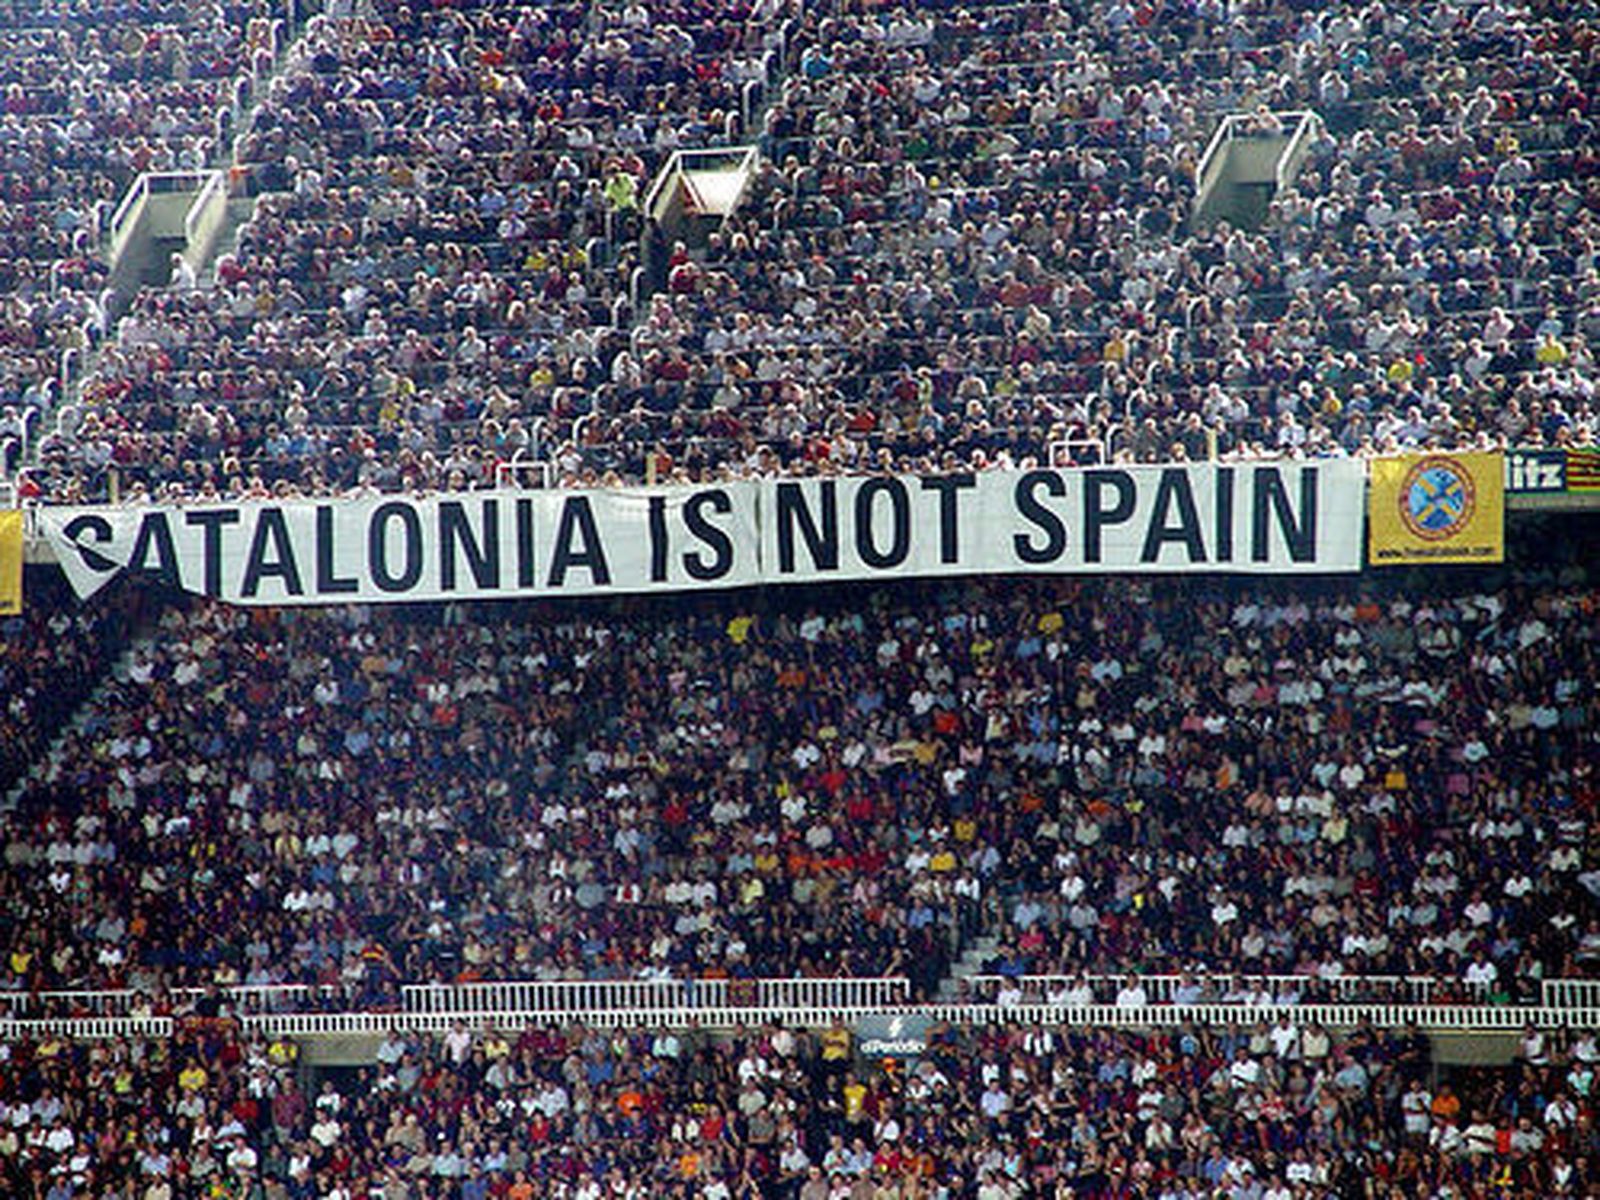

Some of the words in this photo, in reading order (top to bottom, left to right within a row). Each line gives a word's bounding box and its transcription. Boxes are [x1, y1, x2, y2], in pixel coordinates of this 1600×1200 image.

[650, 490, 733, 583] IS
[777, 473, 976, 573] NOT
[1012, 467, 1319, 564] SPAIN
